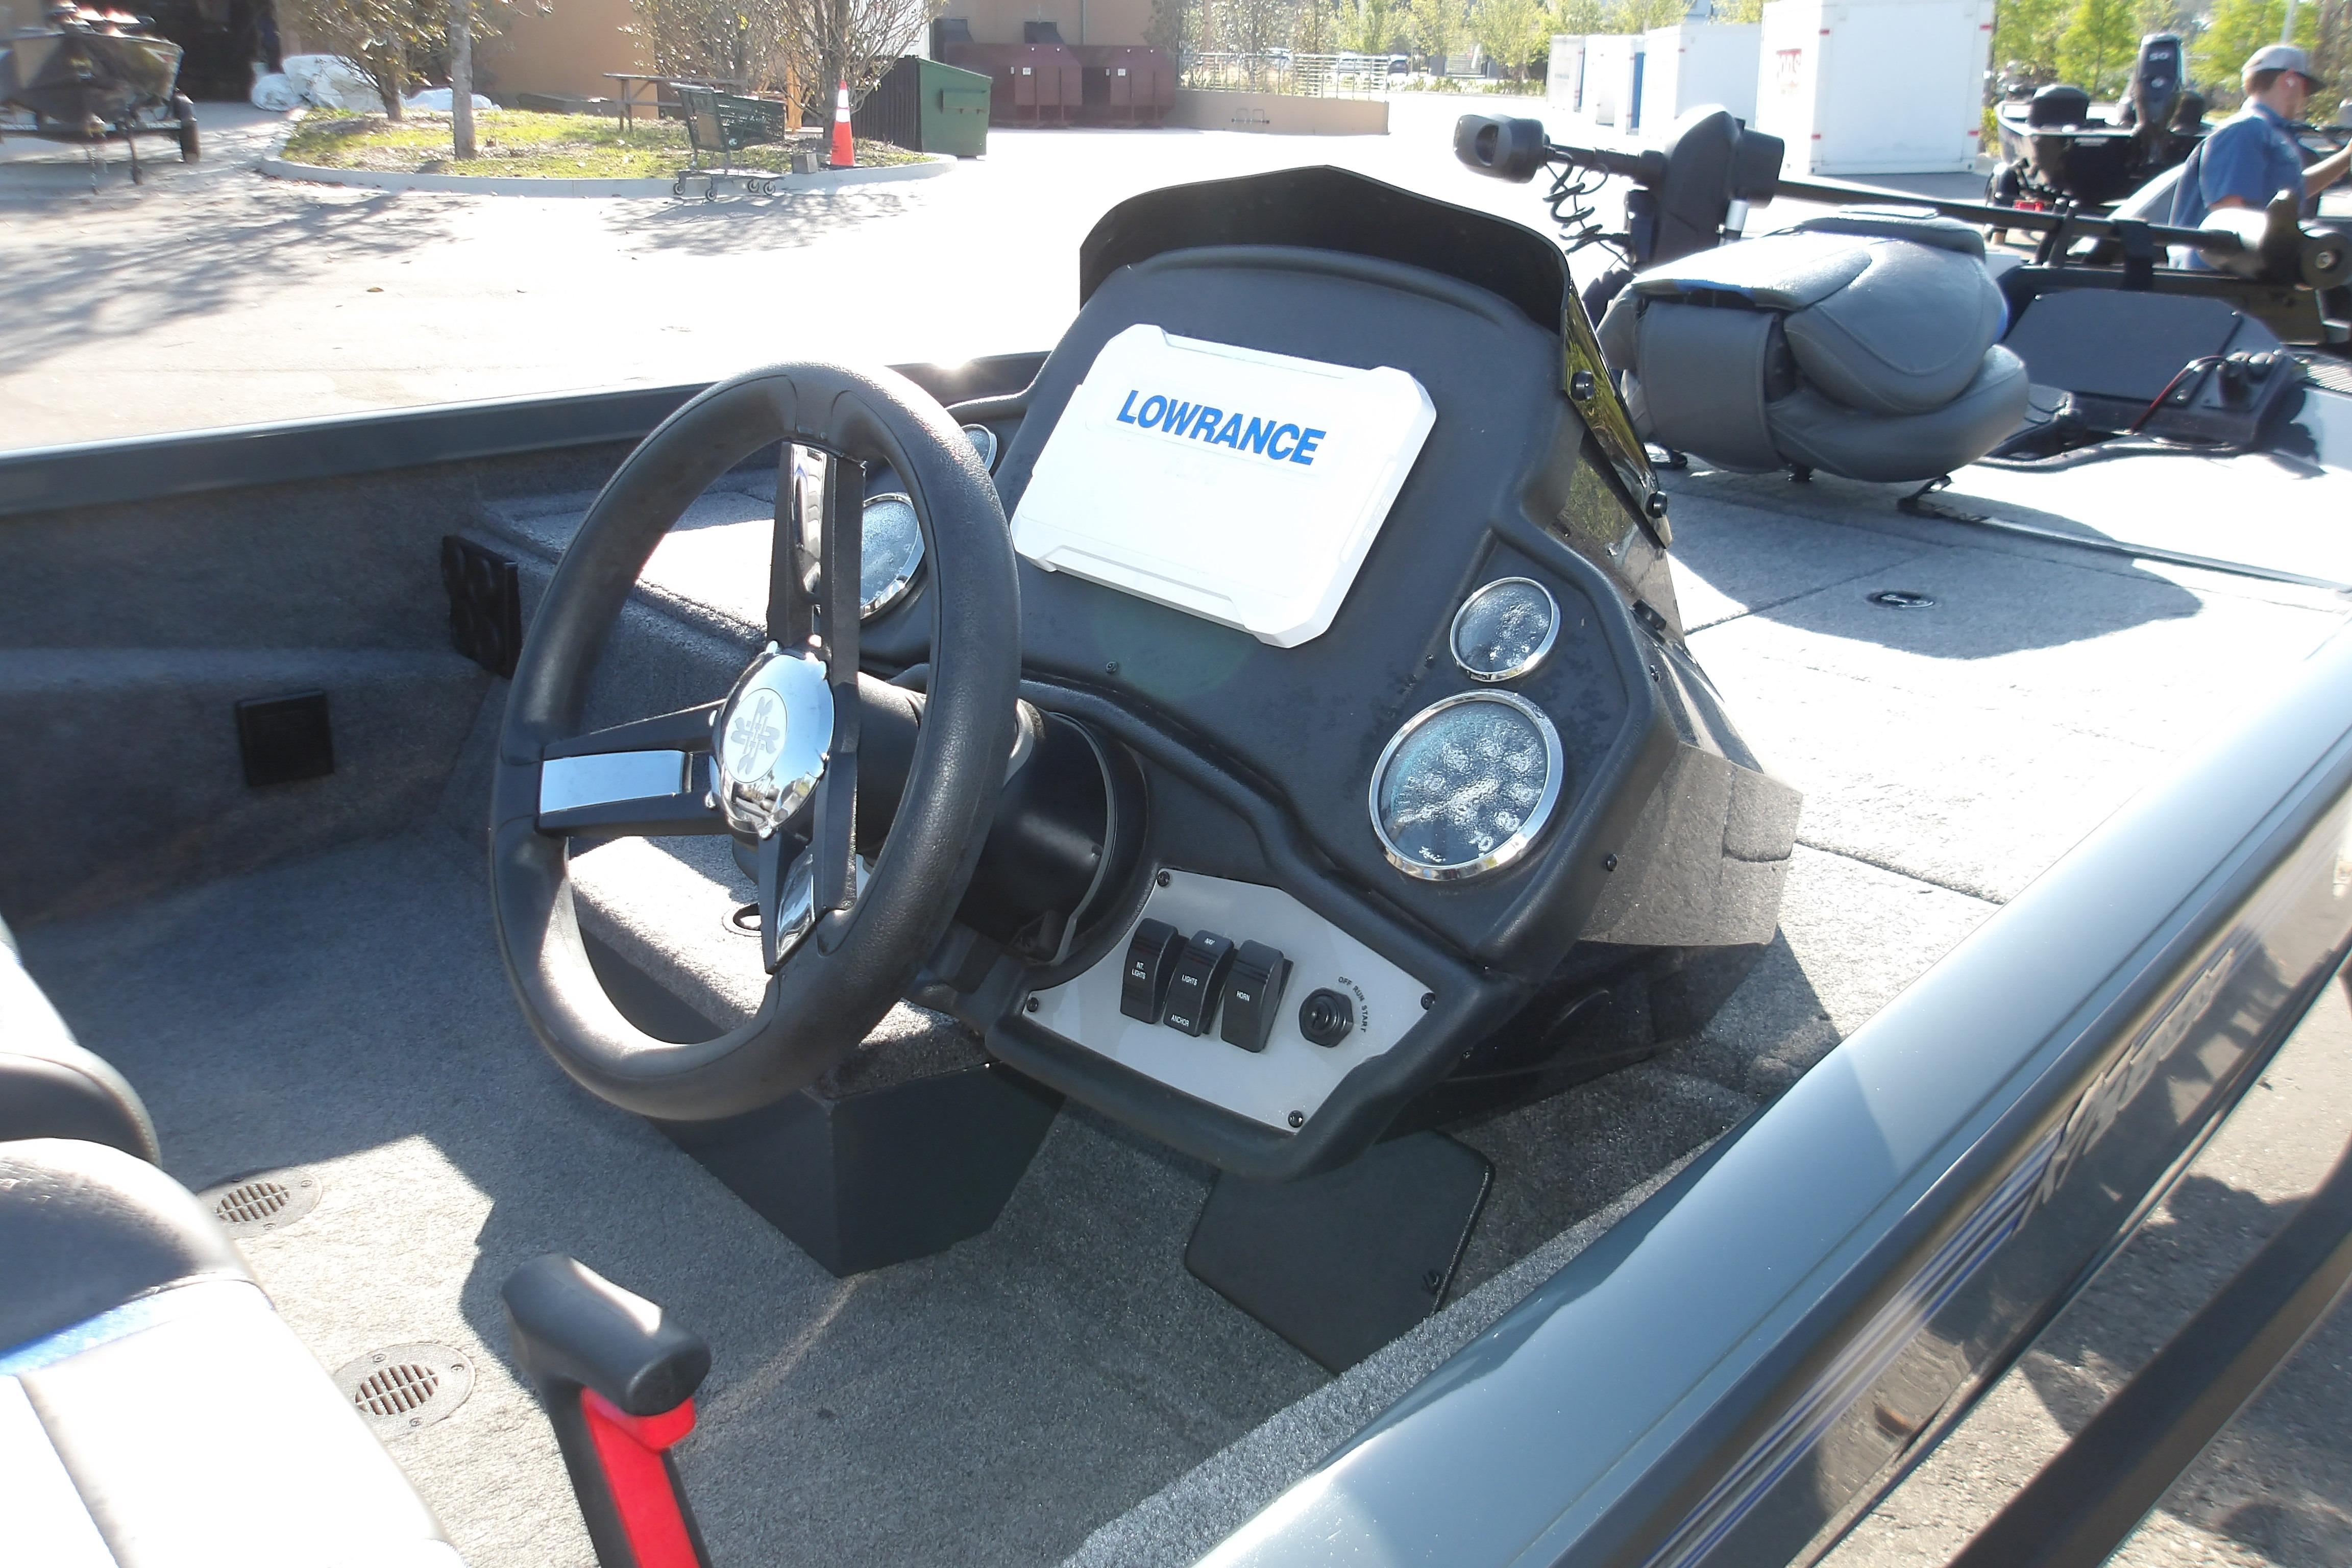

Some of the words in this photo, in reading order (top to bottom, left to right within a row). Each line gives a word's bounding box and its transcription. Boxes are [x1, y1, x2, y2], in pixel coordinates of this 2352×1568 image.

[1116, 390, 1327, 465] LOWRANCE
[1132, 968, 1146, 979] LIGHTS
[1182, 974, 1197, 986] LIGHTS
[1338, 976, 1352, 985] OFF
[1353, 986, 1364, 1001] RUN
[1236, 991, 1250, 1001] HORN
[1171, 1014, 1189, 1026] ANCHOR
